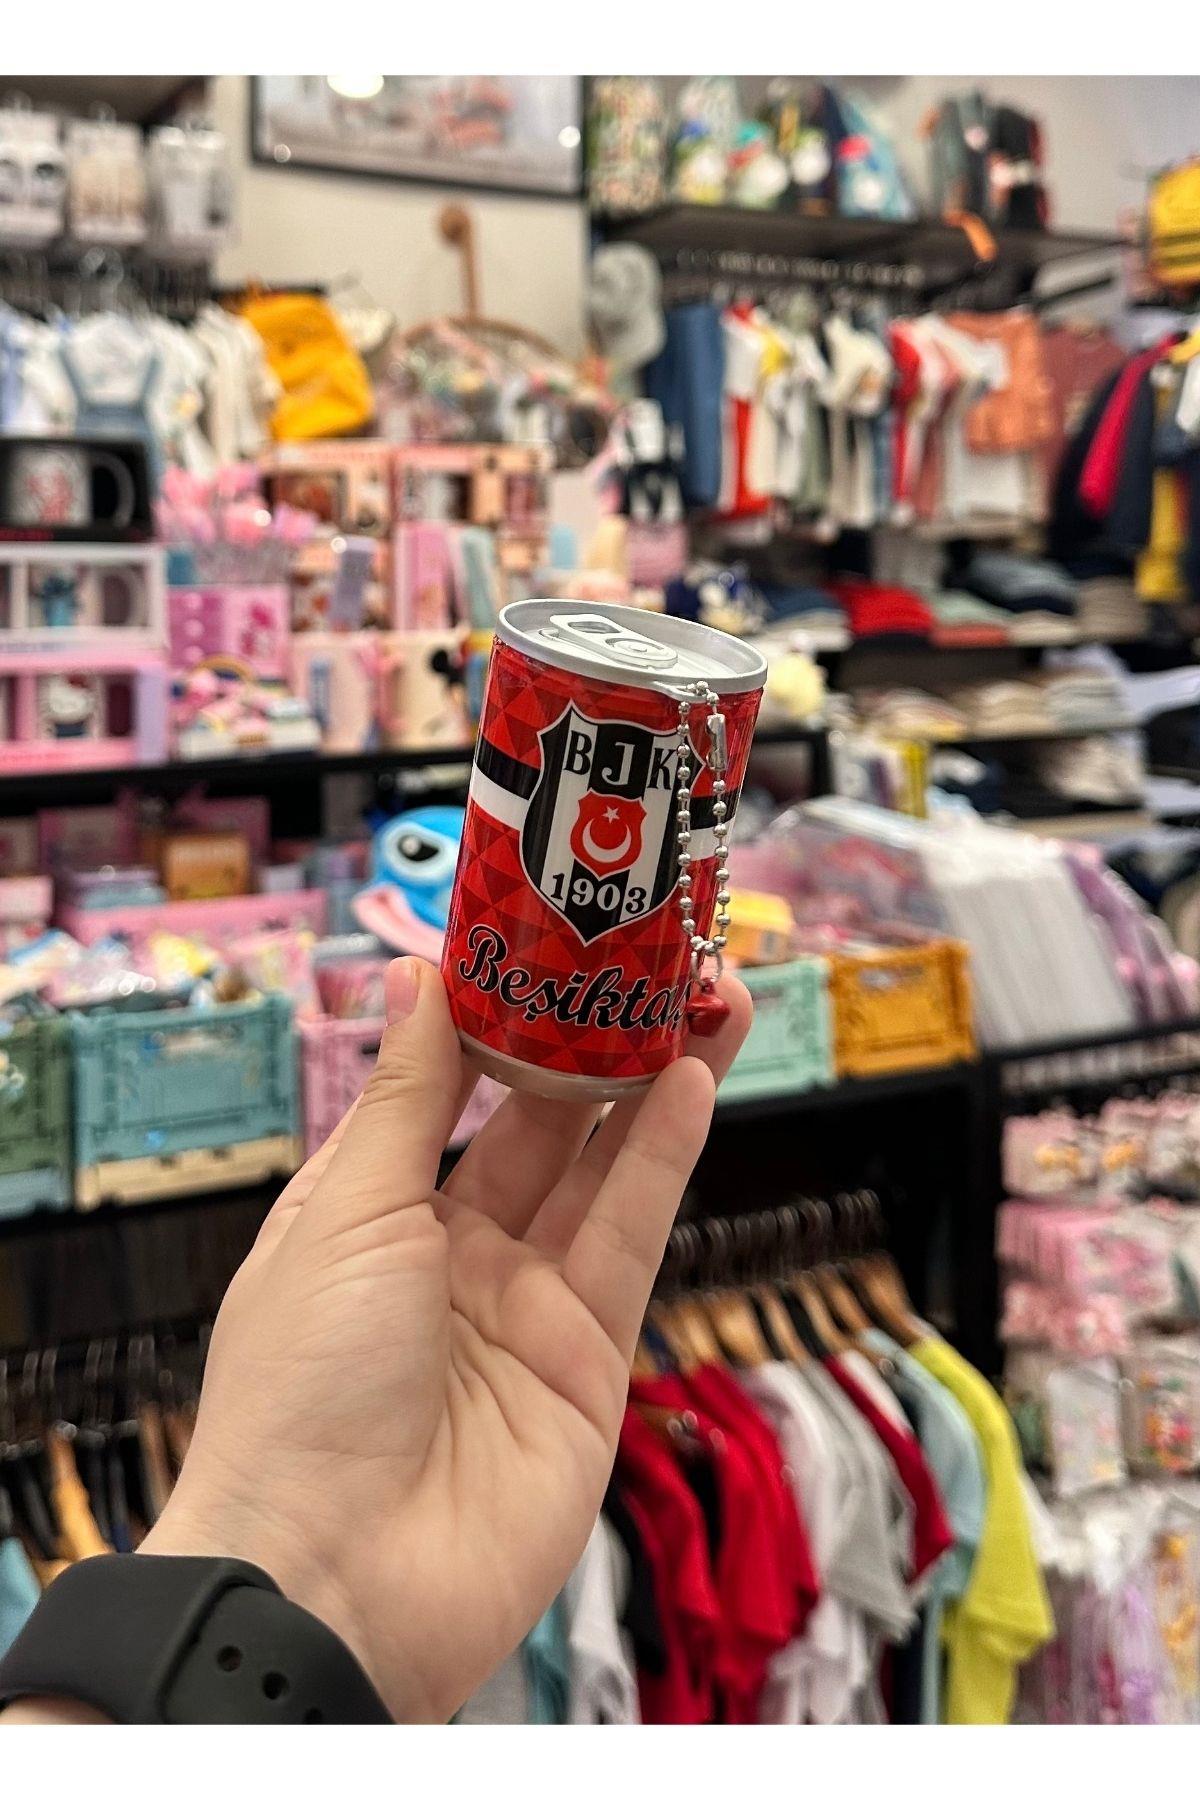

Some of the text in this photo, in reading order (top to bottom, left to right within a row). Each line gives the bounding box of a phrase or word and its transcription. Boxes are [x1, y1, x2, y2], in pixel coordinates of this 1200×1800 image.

[563, 729, 679, 791] BJK
[550, 872, 648, 915] 1903
[458, 923, 692, 1033] Beşiktaş
